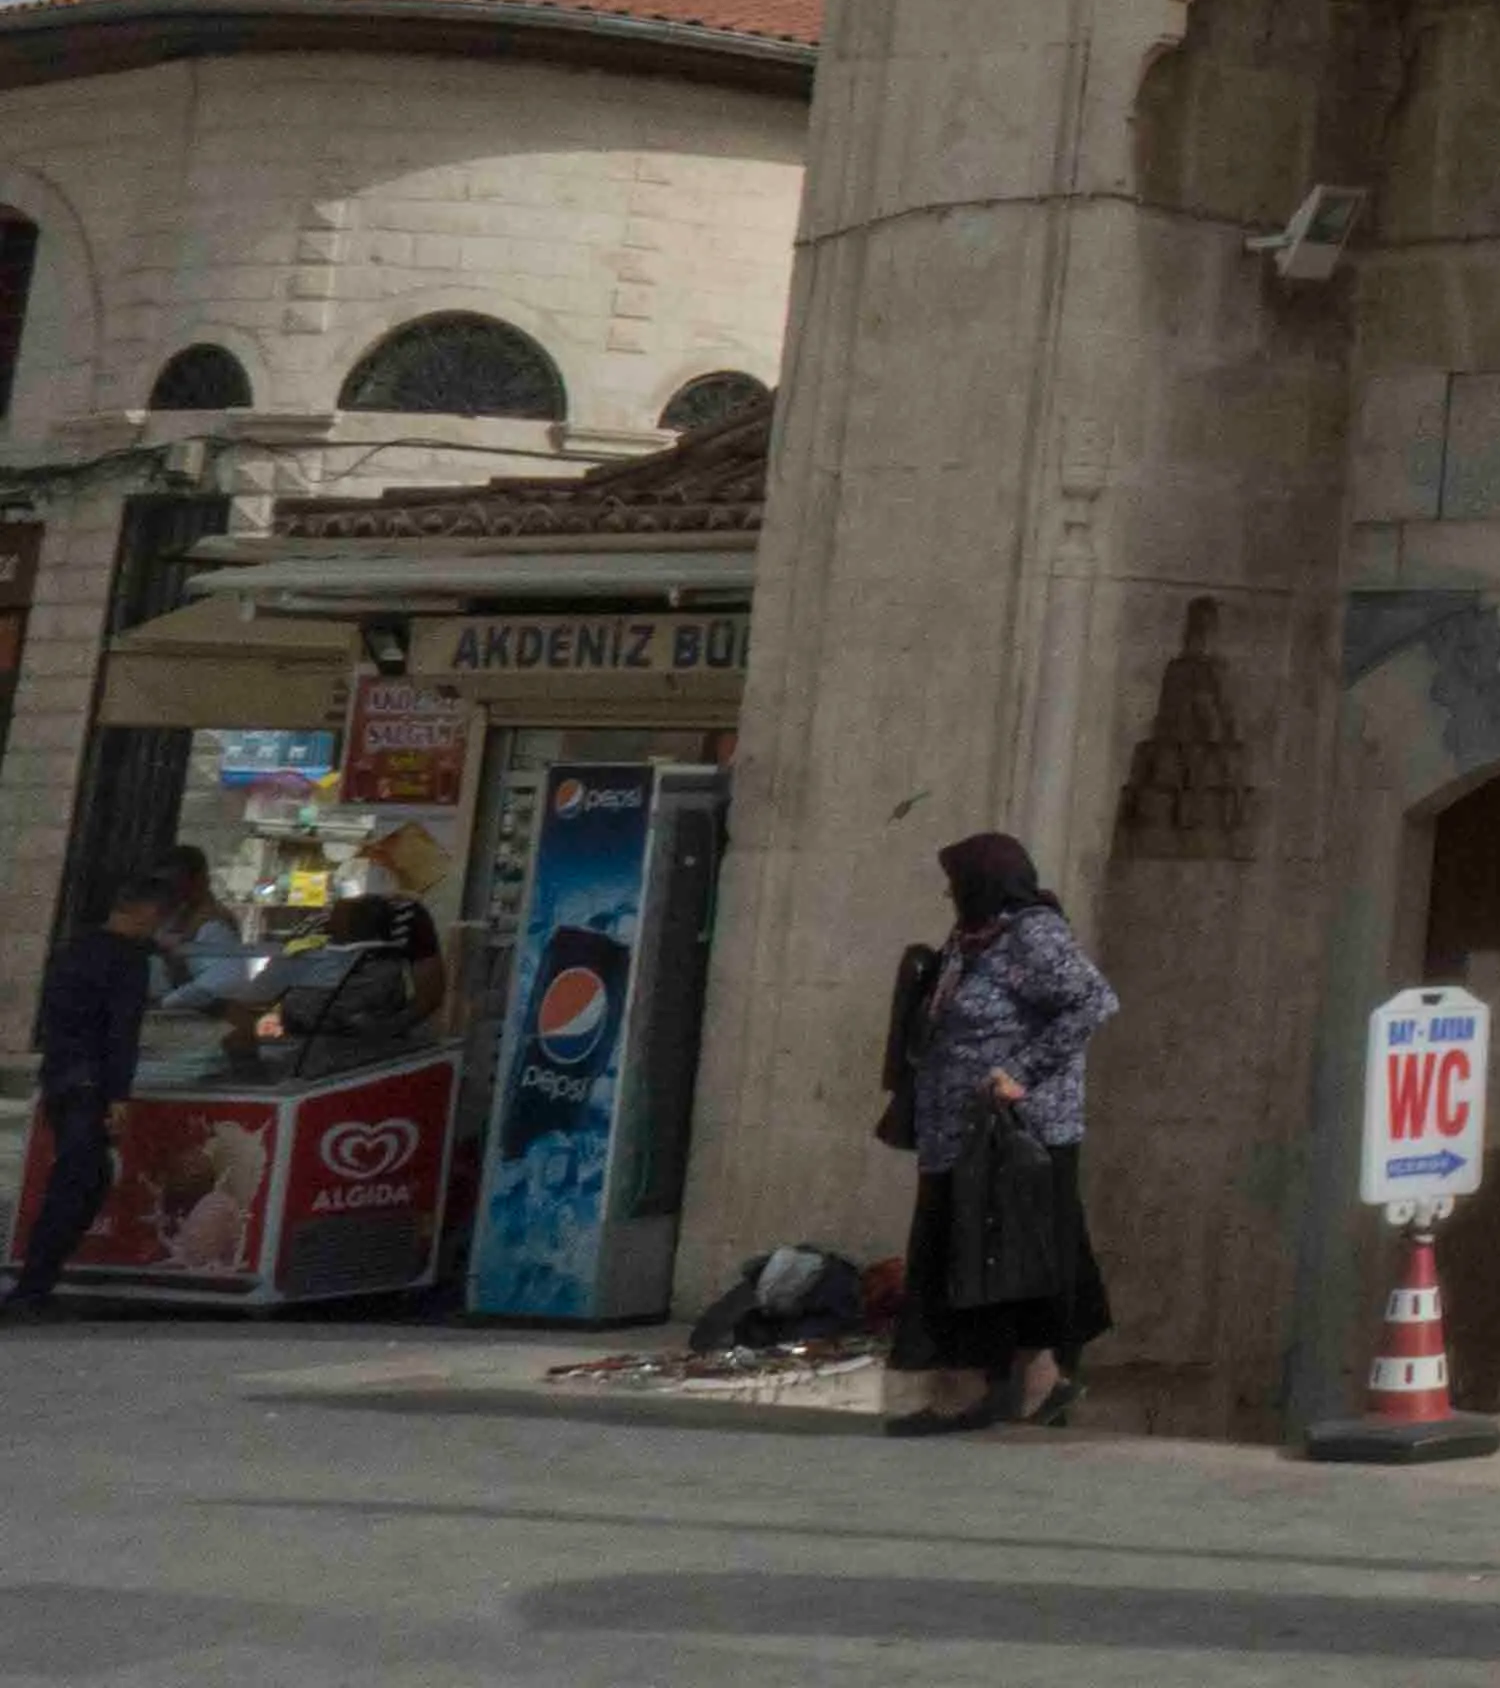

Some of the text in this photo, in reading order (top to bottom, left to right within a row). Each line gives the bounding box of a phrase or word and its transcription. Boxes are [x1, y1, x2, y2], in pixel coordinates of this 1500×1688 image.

[454, 617, 655, 669] AKDENİZ
[584, 784, 643, 812] pepsi
[521, 1064, 592, 1103] pepsi
[1387, 1047, 1471, 1141] WC
[311, 1183, 411, 1212] ALGIDA
